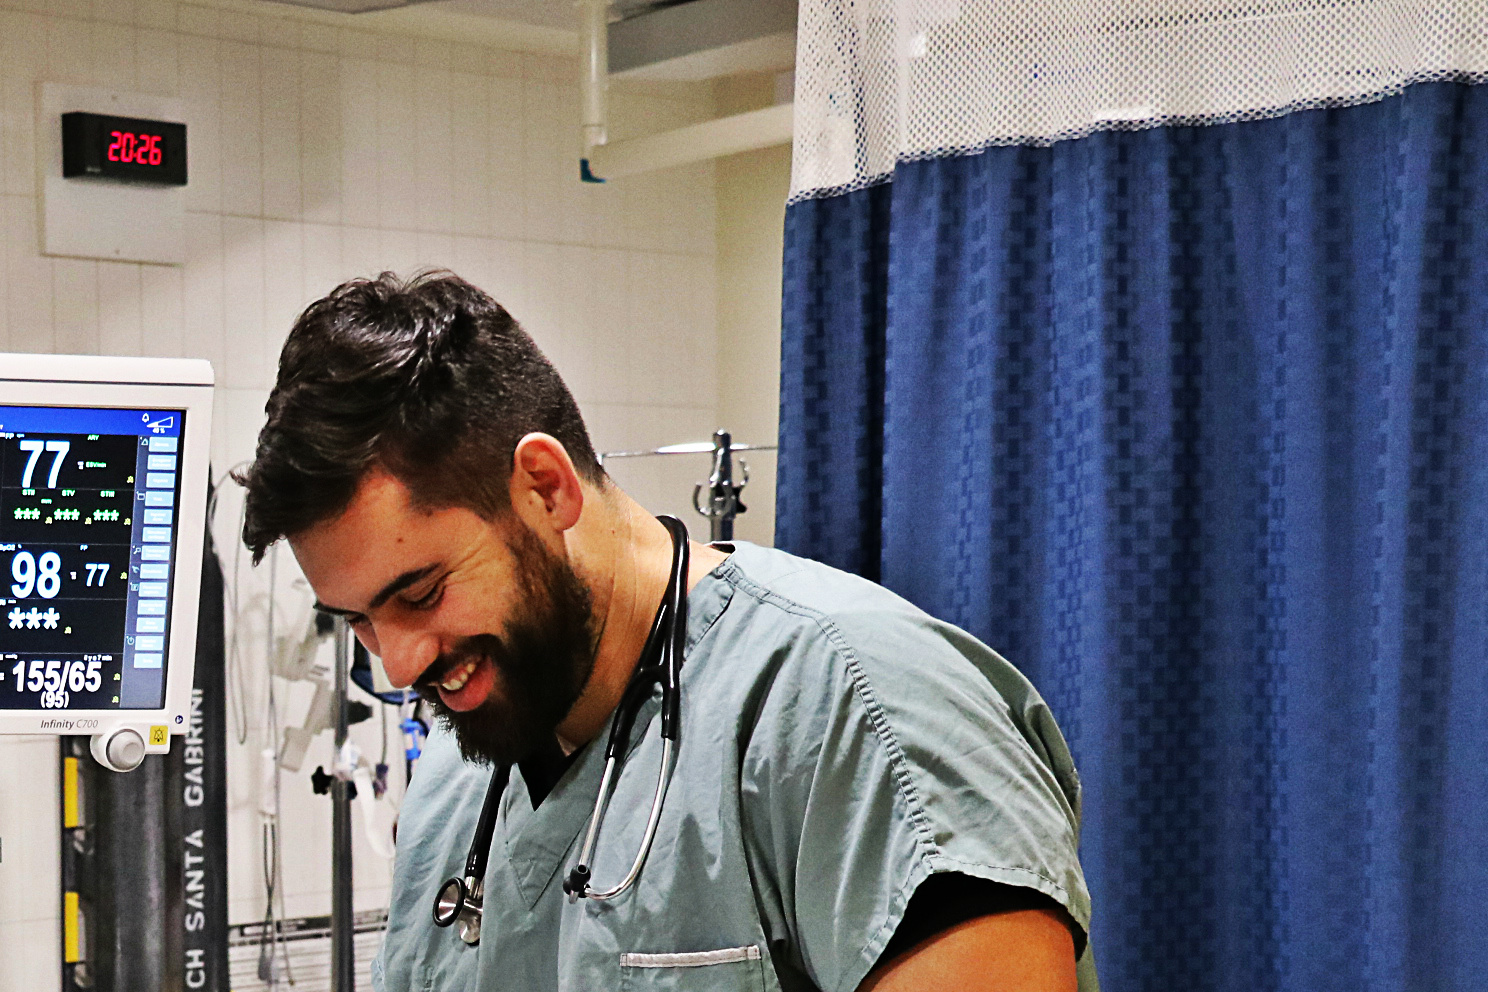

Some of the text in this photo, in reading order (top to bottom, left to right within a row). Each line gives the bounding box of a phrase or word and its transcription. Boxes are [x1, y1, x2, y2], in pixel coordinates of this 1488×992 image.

[108, 131, 162, 165] 20:26
[19, 440, 70, 489] 77
[11, 551, 110, 599] 98 77
[12, 660, 102, 692] 155/65
[41, 691, 69, 708] (95)
[41, 719, 99, 730] Infinity C700
[184, 829, 206, 933] SANTA
[184, 949, 206, 989] CH
